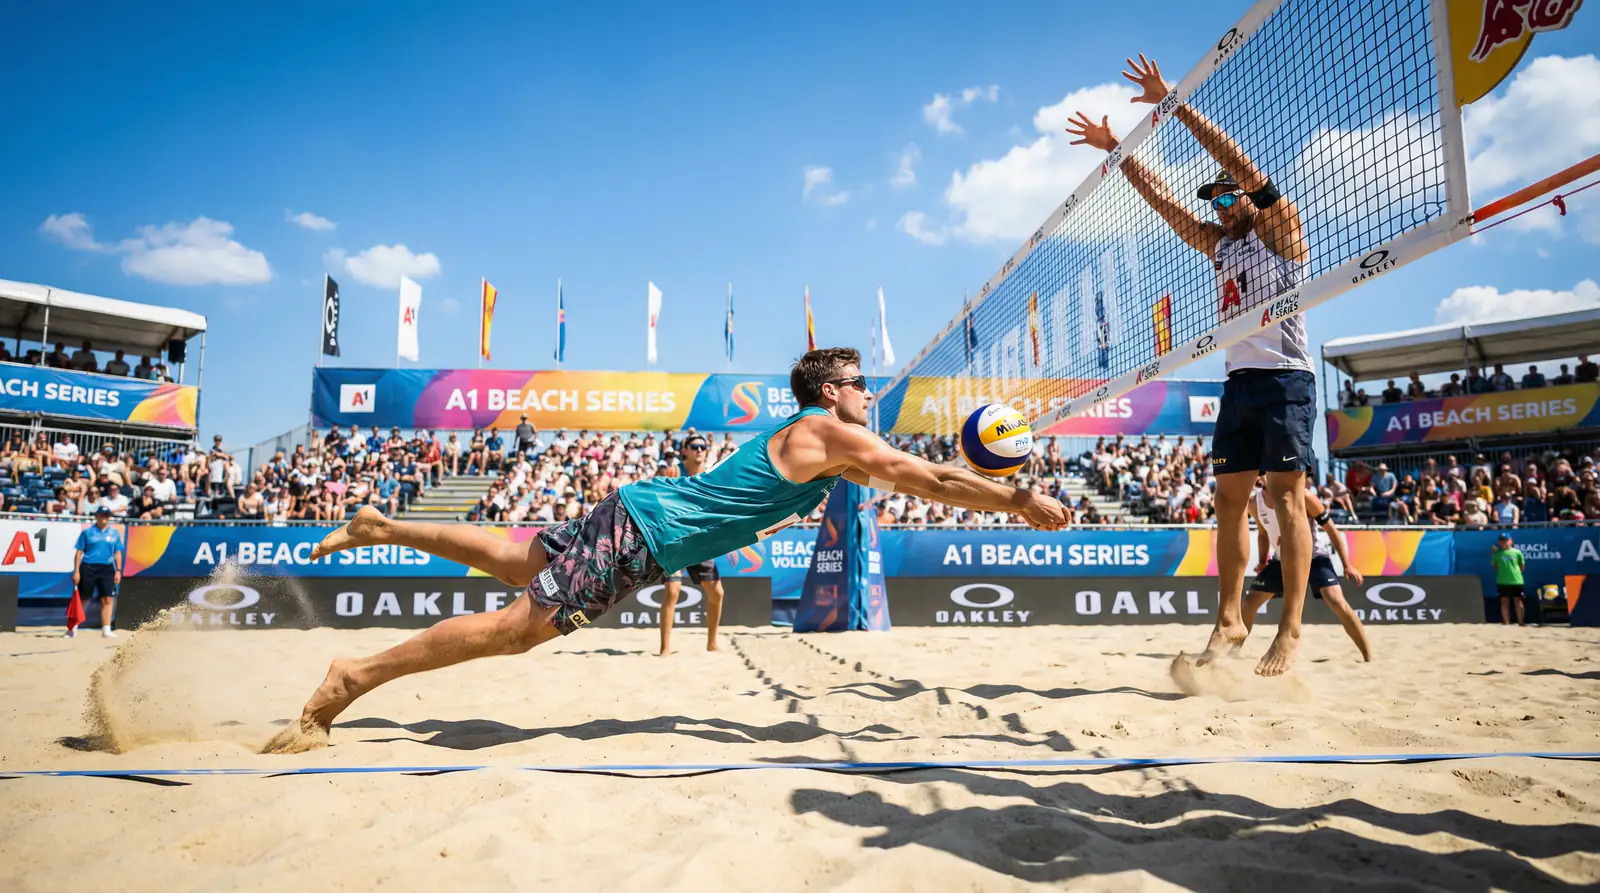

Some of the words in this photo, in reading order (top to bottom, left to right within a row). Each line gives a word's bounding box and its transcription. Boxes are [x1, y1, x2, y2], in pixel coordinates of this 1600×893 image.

[1352, 257, 1398, 284] OAKLEY
[1261, 304, 1275, 327] A1
[1275, 301, 1298, 318] SERIES
[44, 383, 120, 407] SERIES
[352, 390, 369, 406] A1
[445, 388, 477, 410] A1
[488, 389, 578, 411] BEACH
[586, 390, 676, 412] SERIES
[767, 387, 799, 404] BE
[1386, 414, 1411, 432] A1
[1418, 406, 1490, 428] BEACH
[1497, 398, 1576, 421] SERIES
[2, 528, 47, 565] A1
[193, 541, 227, 565] A1
[817, 550, 843, 562] BEACH
[943, 544, 973, 565] A1
[981, 544, 1063, 565] BEACH
[1068, 544, 1150, 565] SERIES
[816, 562, 842, 573] SERIES
[336, 592, 526, 616] OAKLE
[1354, 608, 1442, 621] OAKLEY
[620, 611, 708, 624] OALE
[935, 610, 1030, 623] OAKLEY
